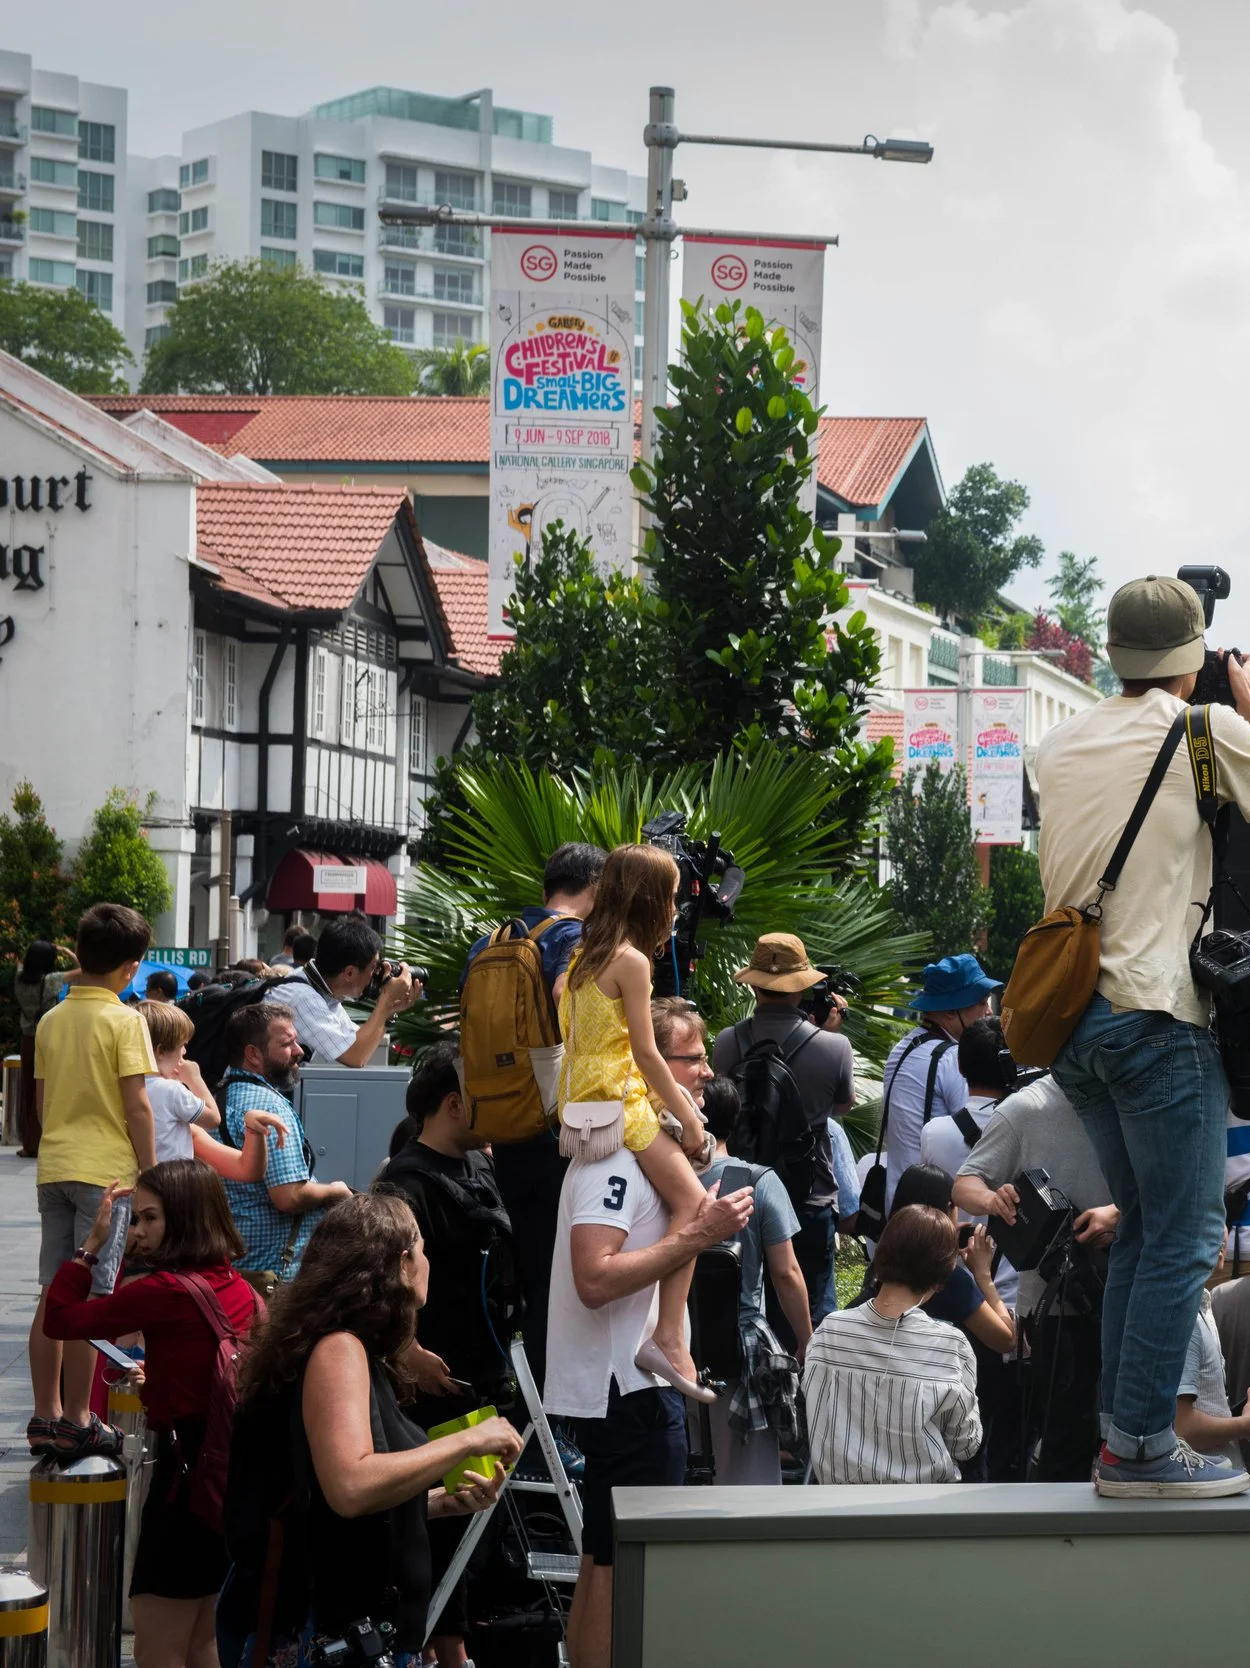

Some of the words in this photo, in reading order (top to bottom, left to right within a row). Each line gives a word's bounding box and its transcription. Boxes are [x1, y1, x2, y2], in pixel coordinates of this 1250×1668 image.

[564, 249, 603, 260] Passion
[526, 256, 552, 270] SG
[564, 261, 592, 270] Made
[753, 259, 793, 270] Passion
[563, 272, 607, 283] Possible
[717, 266, 743, 280] SG
[753, 271, 782, 281] Made
[753, 282, 795, 293] Possible
[581, 371, 621, 392] BIG
[514, 429, 521, 443] 9
[523, 429, 545, 444] JUN
[557, 431, 563, 443] 9
[565, 431, 584, 445] SEP
[587, 431, 611, 446] 2018
[500, 455, 539, 468] NATIONAL
[542, 456, 576, 469] GALLERY
[579, 457, 625, 470] SINGAPORE
[1193, 736, 1210, 761] D5
[1202, 763, 1211, 792] Nikon
[189, 950, 207, 965] RD
[603, 1175, 627, 1211] 3
